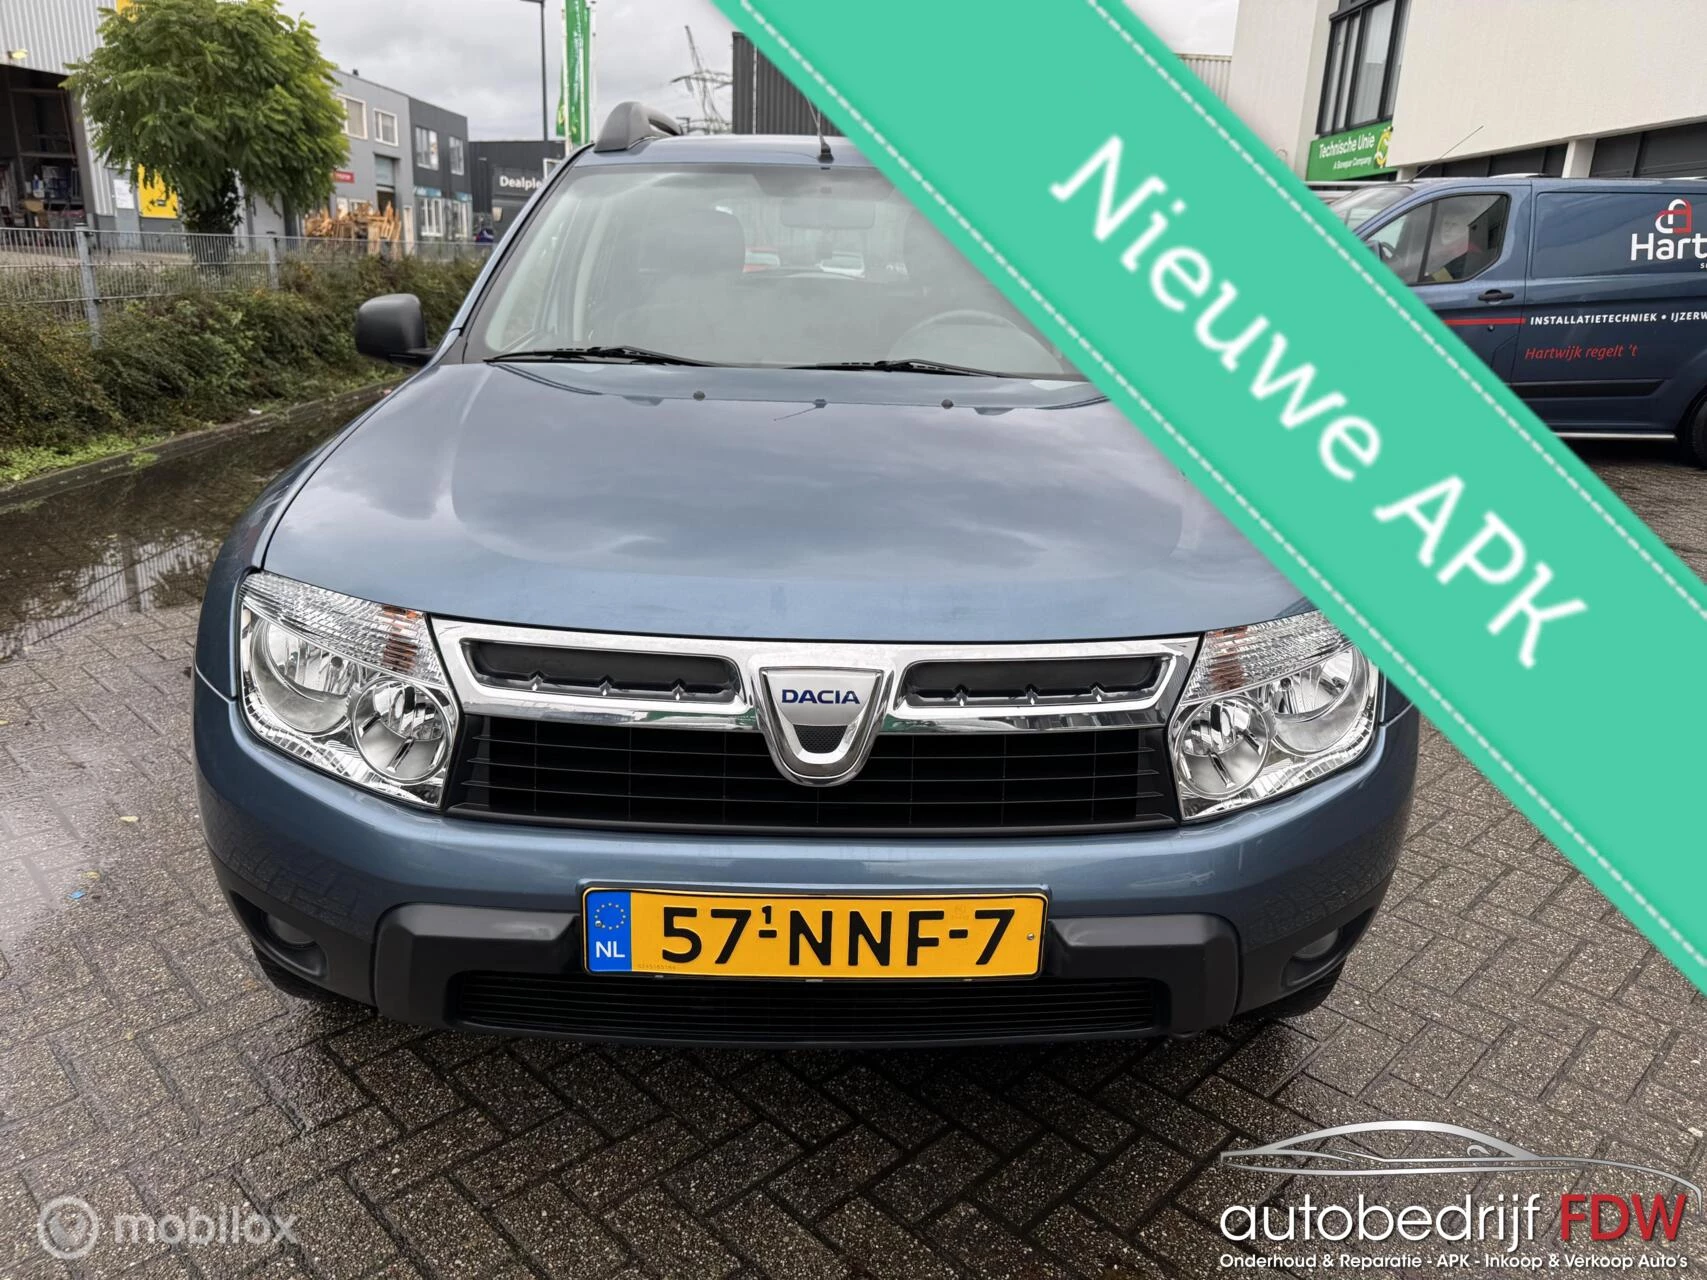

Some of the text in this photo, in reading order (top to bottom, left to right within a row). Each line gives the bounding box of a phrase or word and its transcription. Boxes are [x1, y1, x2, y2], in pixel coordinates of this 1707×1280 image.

[1319, 132, 1375, 158] Technische Unie
[1630, 231, 1707, 261] Hart
[1530, 312, 1658, 326] INSTALLATIETECHNIEK
[1525, 346, 1582, 362] Hartwijk
[1585, 344, 1624, 361] regelt
[781, 689, 860, 705] DACIA
[595, 940, 625, 959] NL
